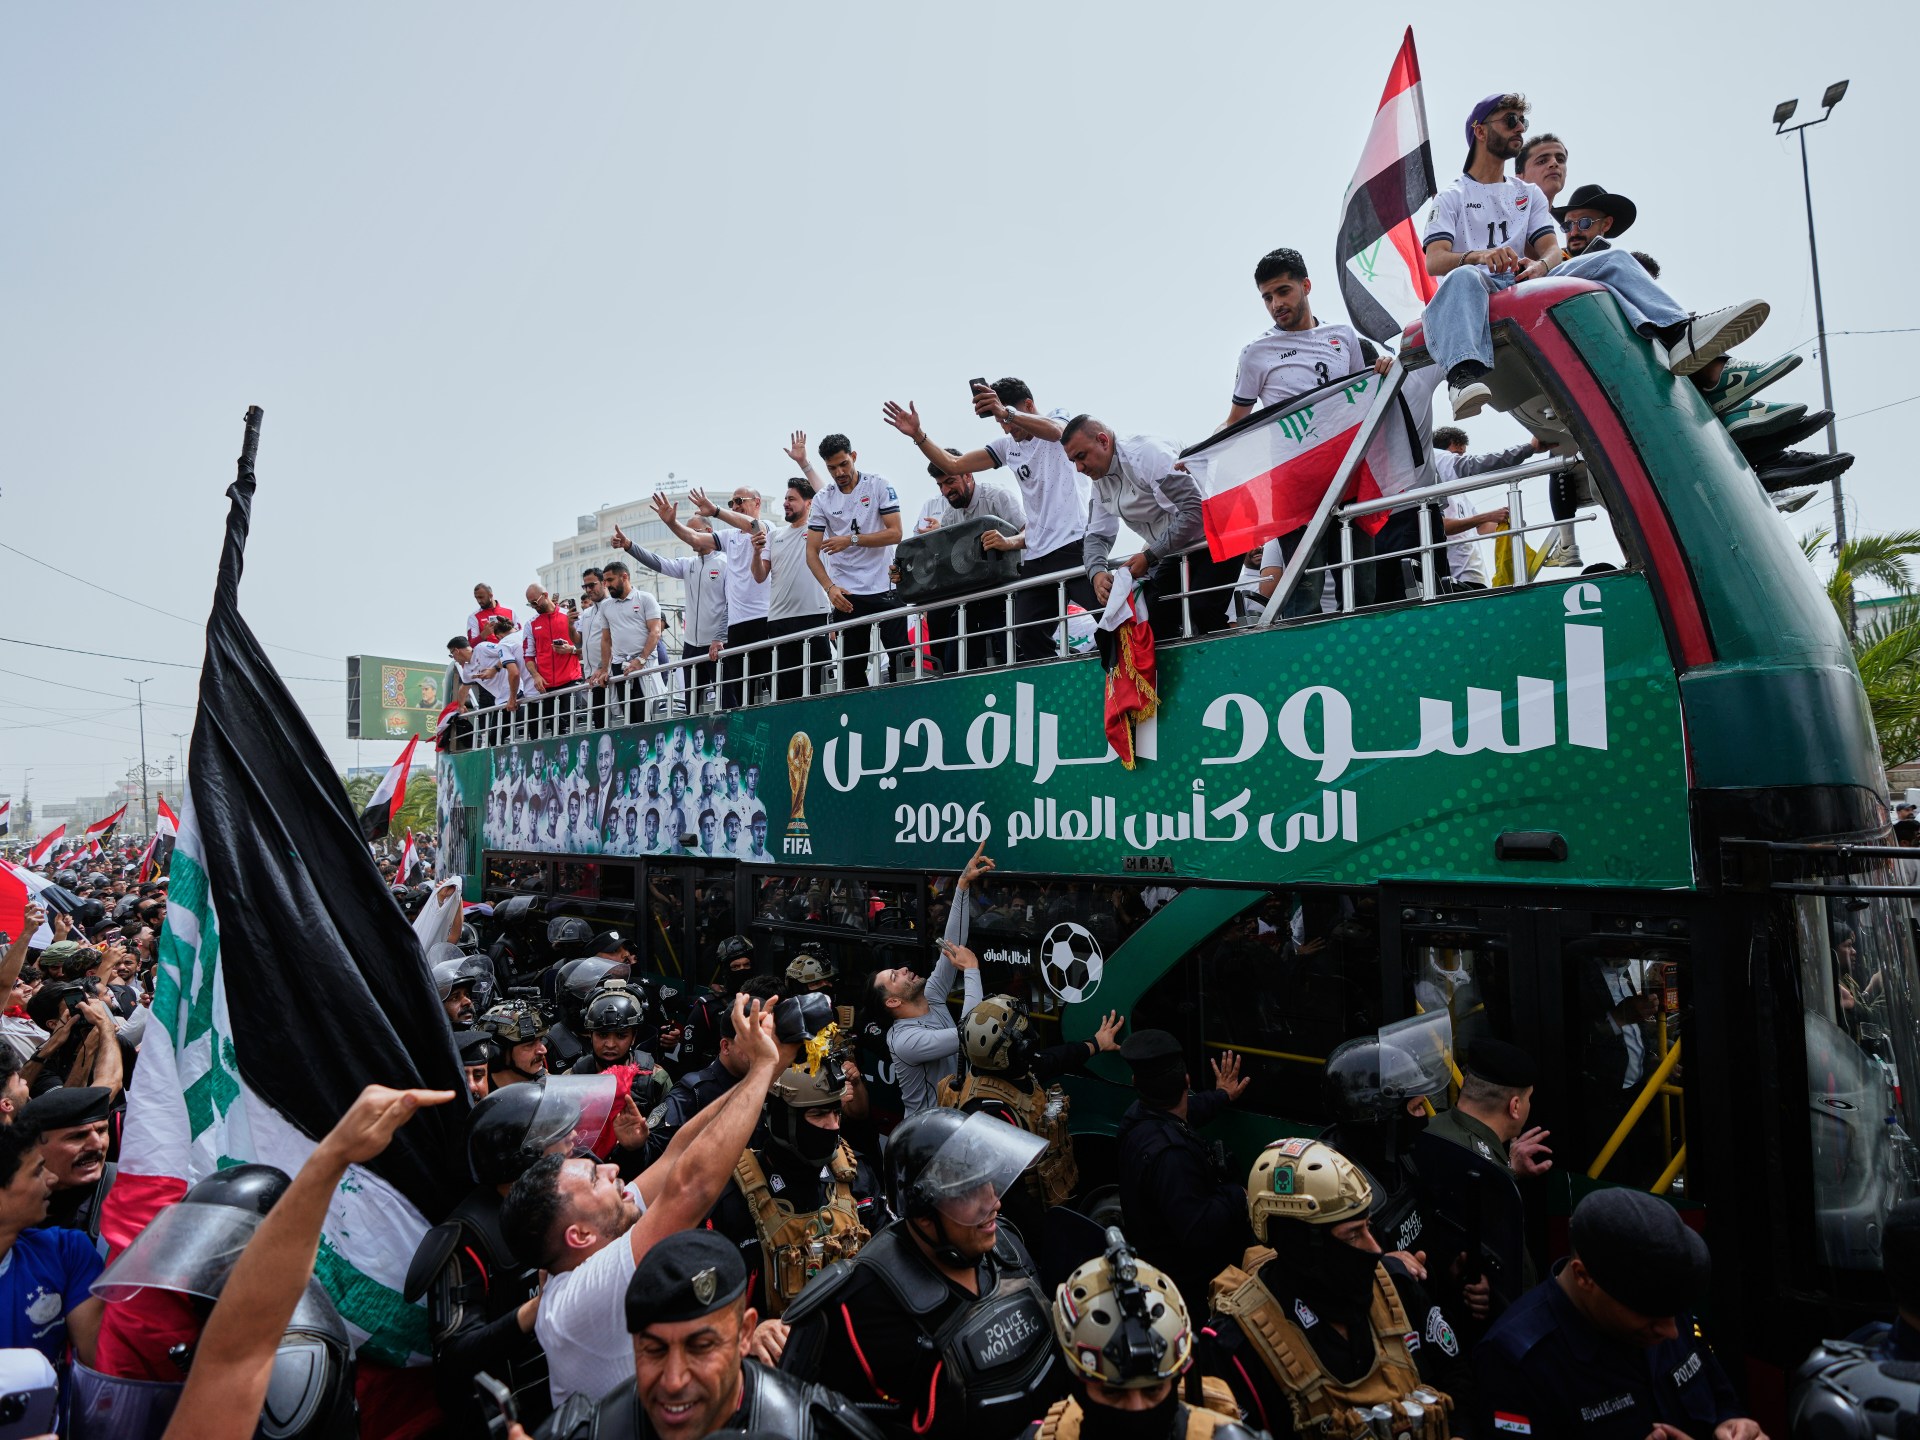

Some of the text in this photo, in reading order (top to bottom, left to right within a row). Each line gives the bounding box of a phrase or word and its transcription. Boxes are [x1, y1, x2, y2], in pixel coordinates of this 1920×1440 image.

[1487, 221, 1511, 249] 11
[1280, 350, 1297, 360] JAKO
[1315, 361, 1328, 385] 3
[850, 518, 860, 534] 4
[1200, 582, 1608, 783] أسود
[895, 801, 991, 843] 2026
[1007, 795, 1116, 848] العالم
[1123, 778, 1251, 850] كأس
[783, 838, 812, 855] FIFA
[1122, 855, 1176, 873] ELBA
[983, 949, 1008, 963] العراق
[985, 1309, 1025, 1343] POLICE
[980, 1337, 1009, 1363] MOI
[1673, 1352, 1702, 1387] POLICE
